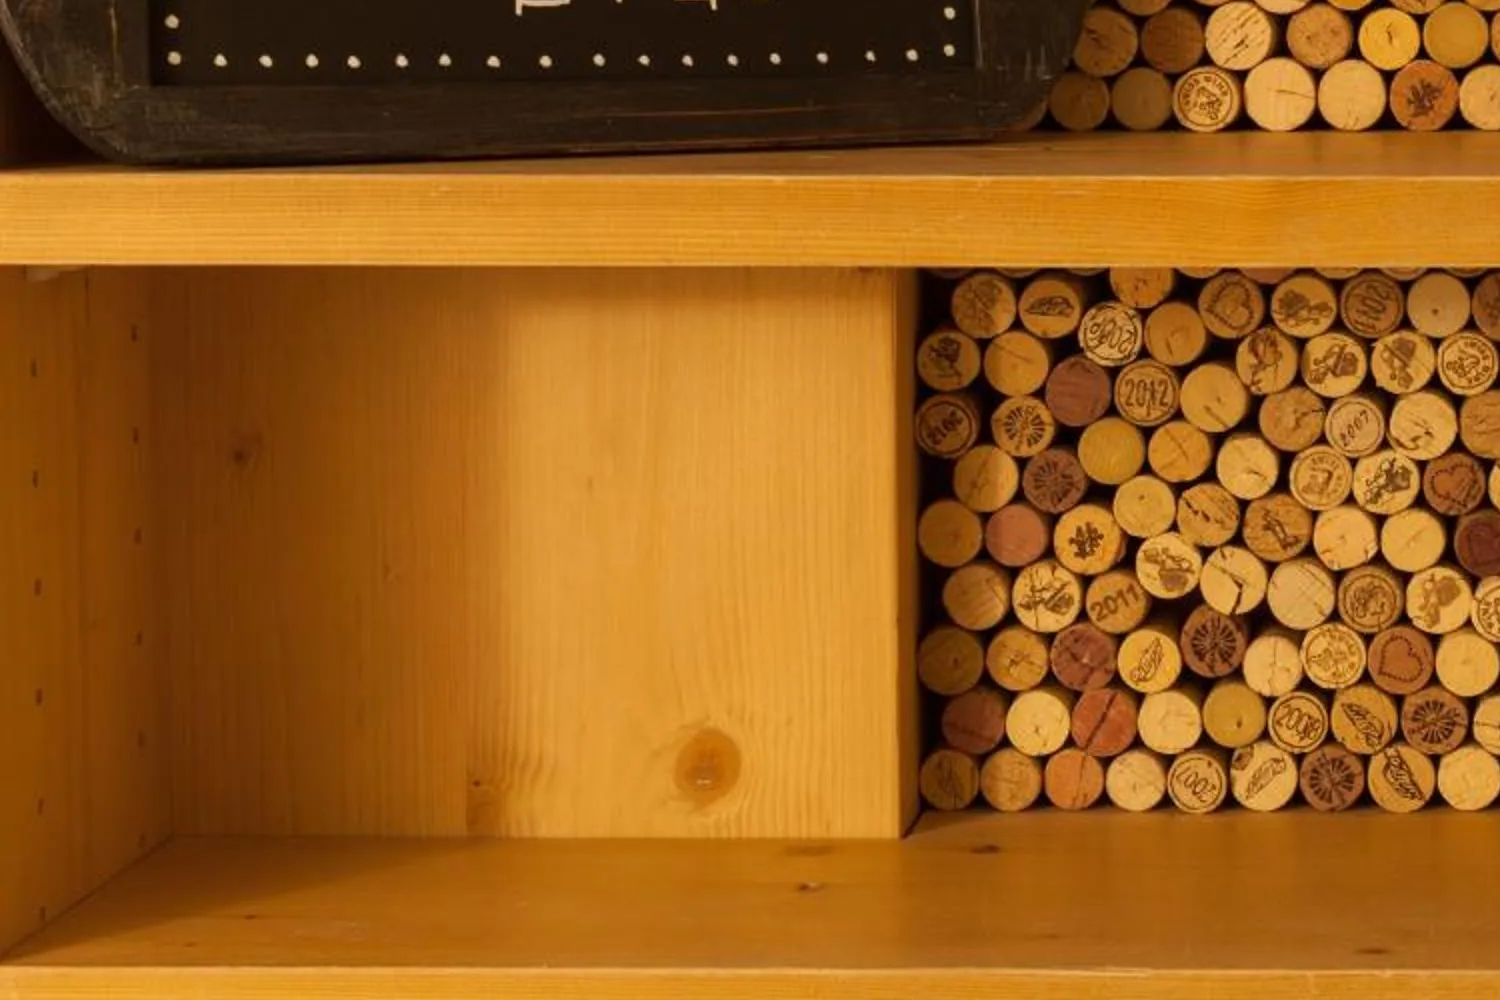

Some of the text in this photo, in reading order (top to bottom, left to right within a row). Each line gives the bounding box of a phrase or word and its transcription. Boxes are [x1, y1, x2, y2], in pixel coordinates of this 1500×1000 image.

[1183, 75, 1229, 106] SWISS WINE
[1125, 378, 1169, 407] 2012
[1091, 584, 1140, 621] 2011
